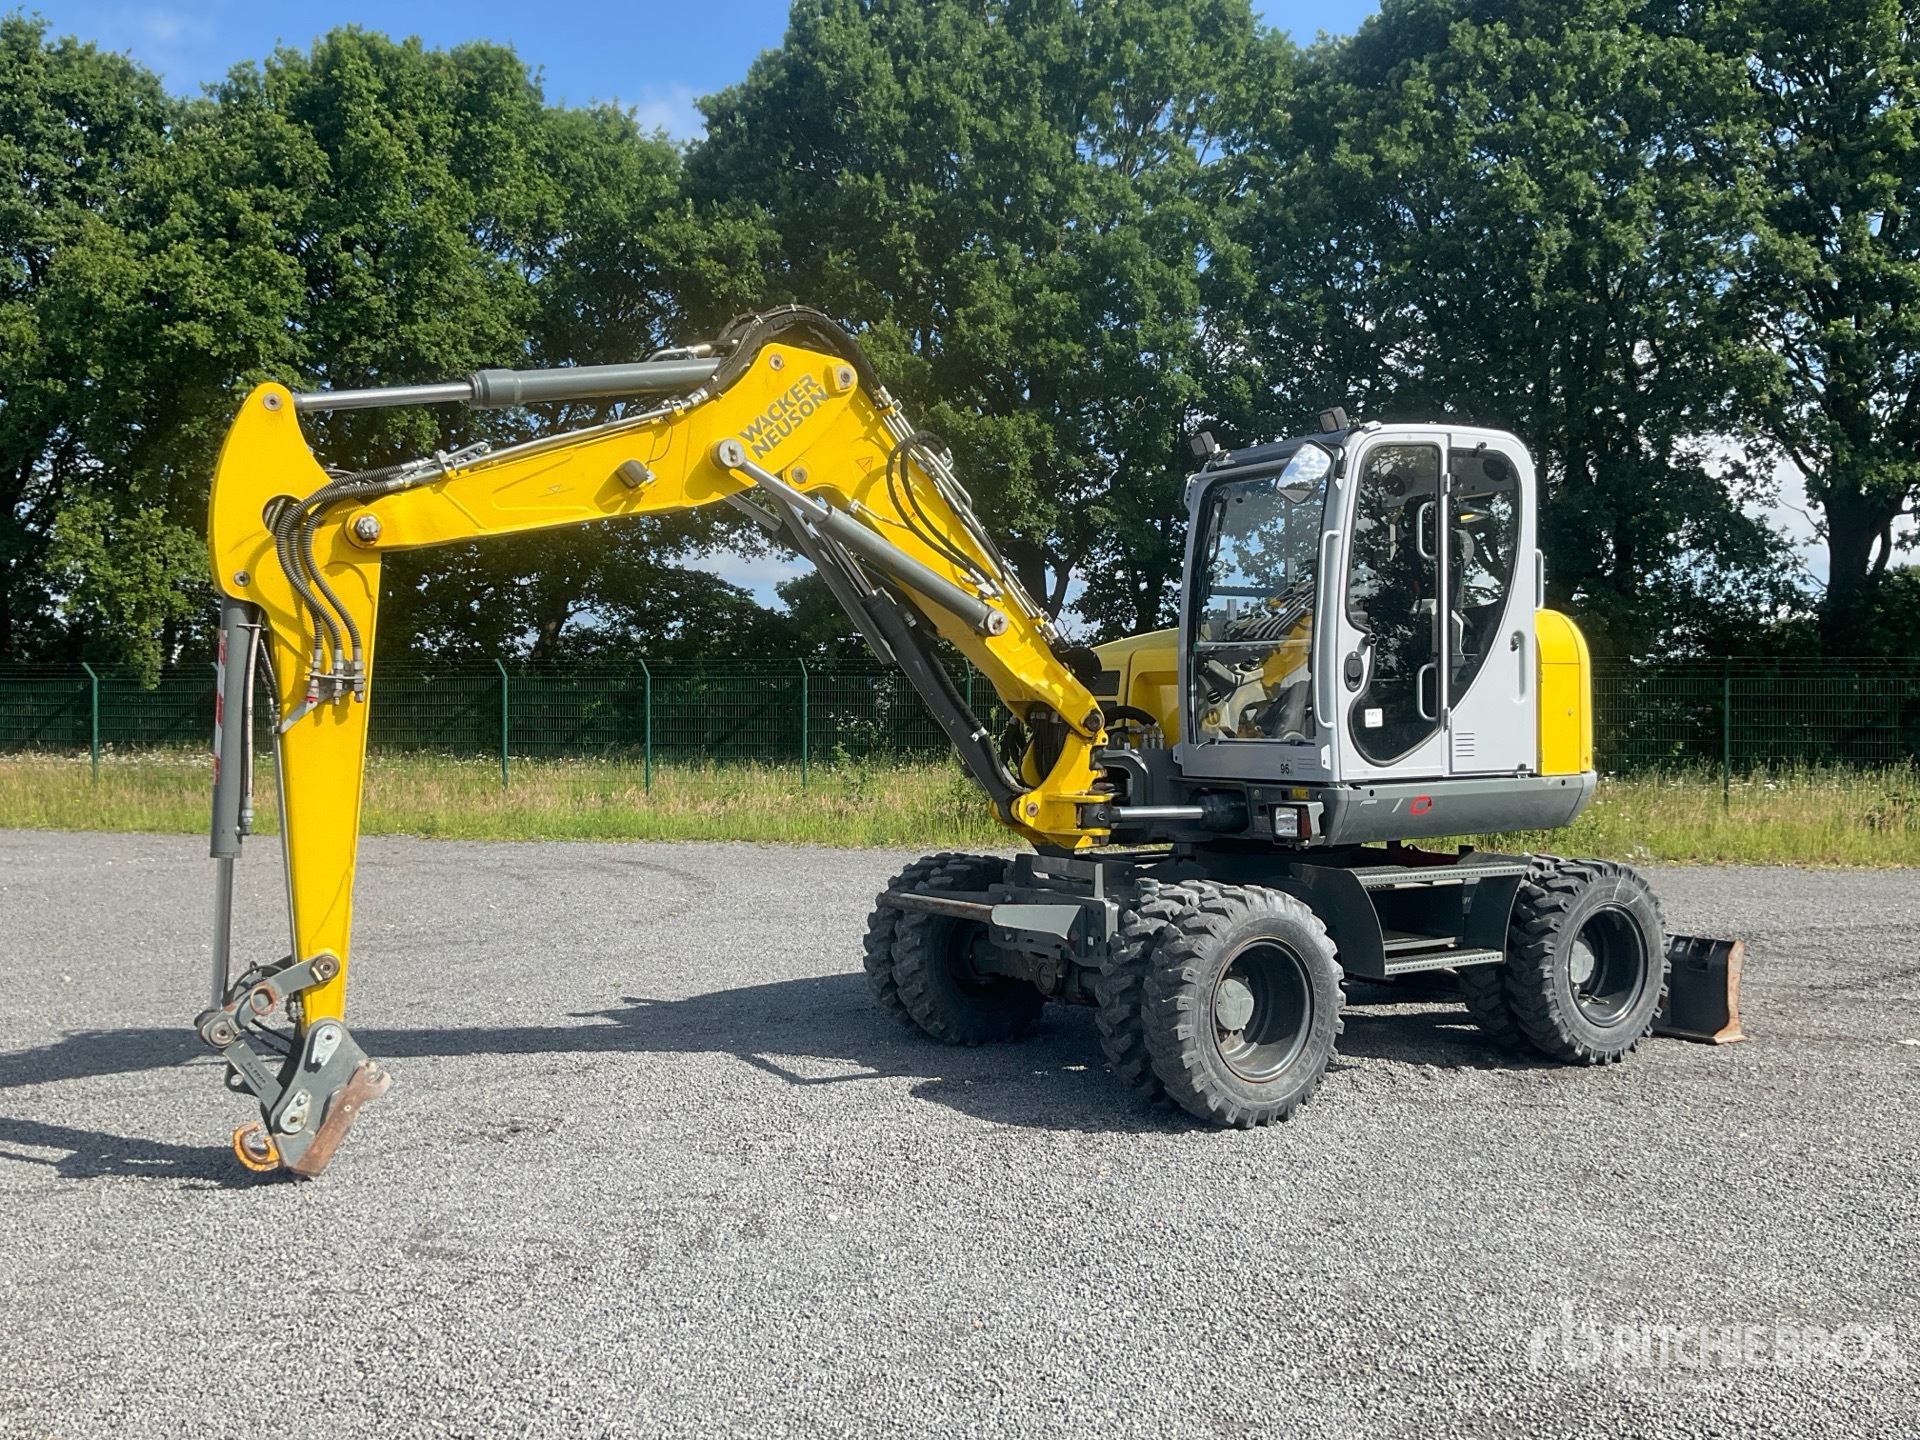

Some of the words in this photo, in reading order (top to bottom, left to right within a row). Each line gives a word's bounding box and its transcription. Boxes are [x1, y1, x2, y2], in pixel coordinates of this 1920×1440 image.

[738, 374, 819, 443] WACKER
[751, 386, 829, 460] NEUSON
[1280, 763, 1290, 775] 96
